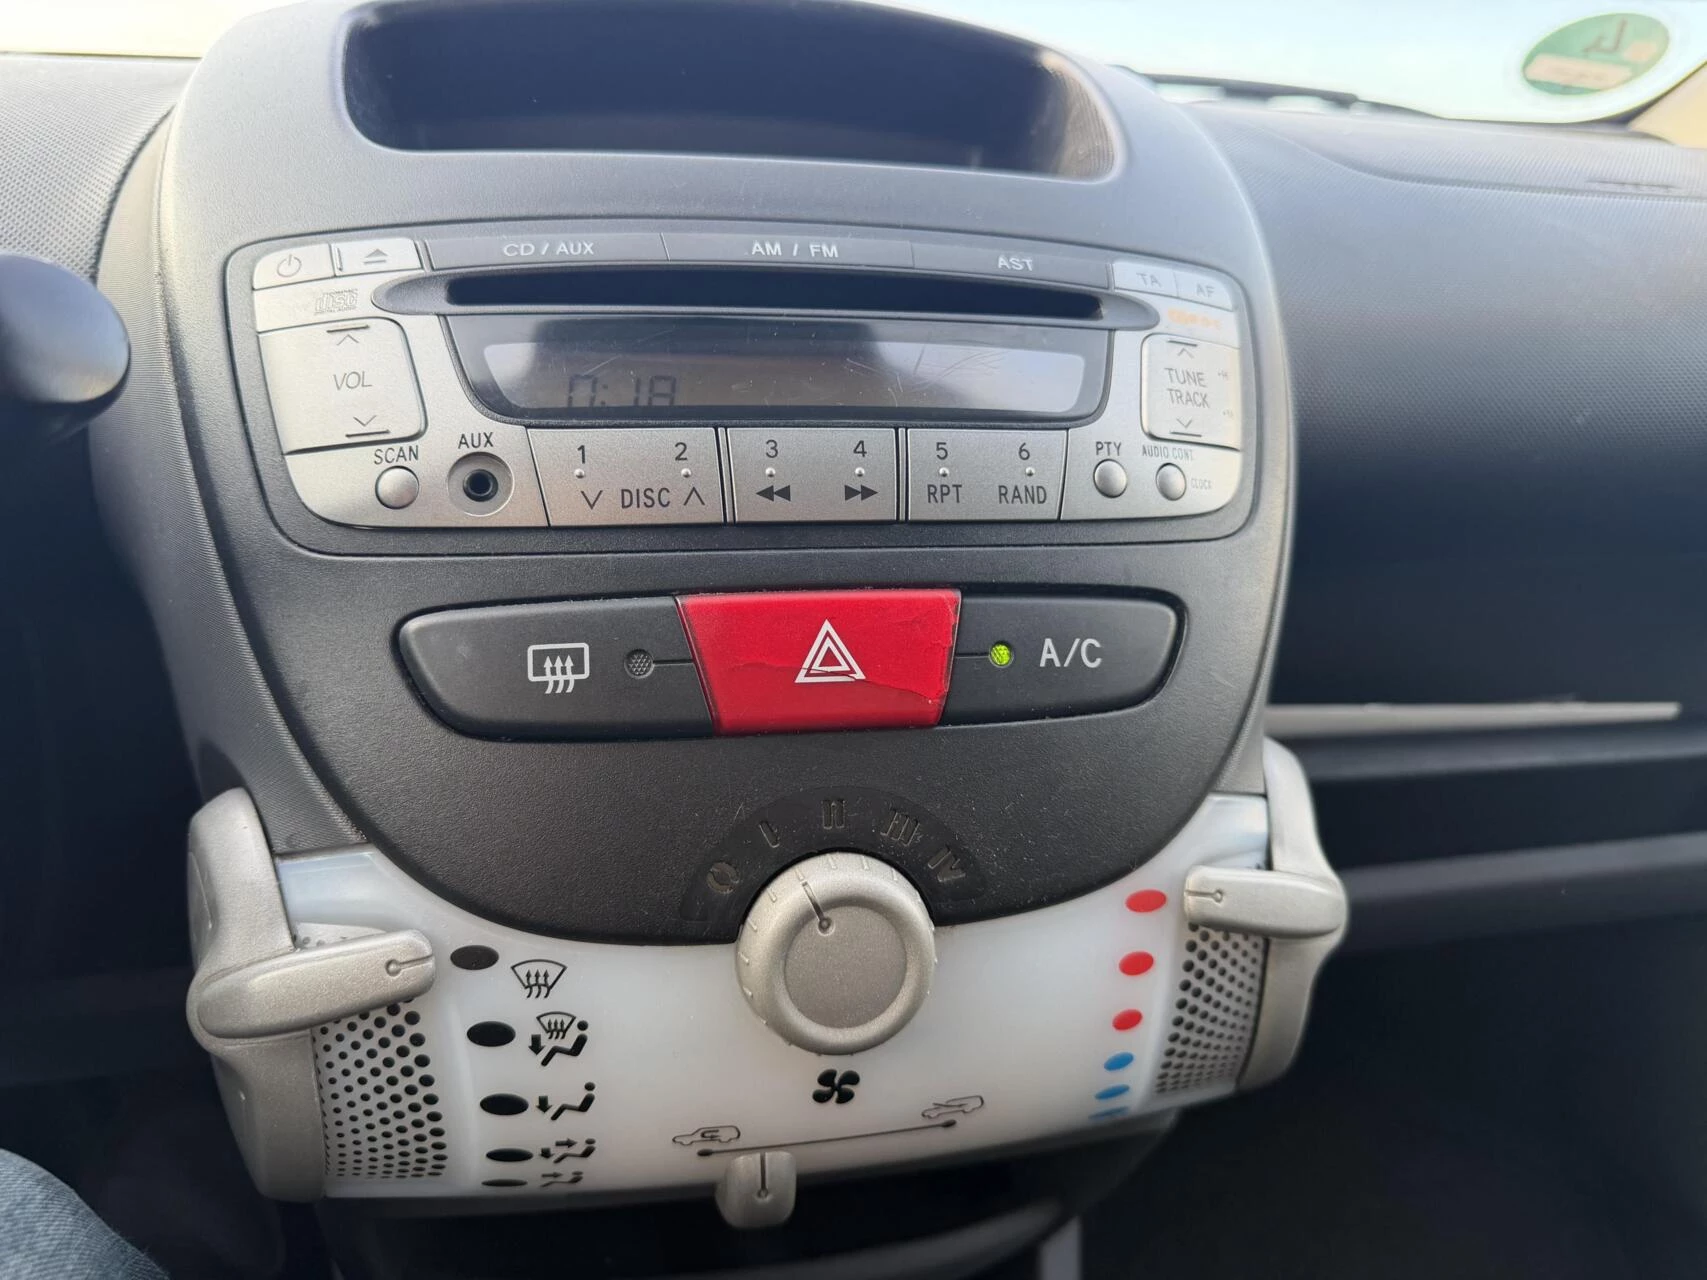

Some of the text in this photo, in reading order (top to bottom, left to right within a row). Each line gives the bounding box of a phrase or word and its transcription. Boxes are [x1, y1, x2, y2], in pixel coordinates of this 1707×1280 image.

[503, 243, 536, 257] CD
[556, 240, 595, 255] AUX
[751, 240, 782, 257] AM
[808, 243, 839, 258] FM
[998, 255, 1033, 272] AST
[1136, 272, 1163, 288] TA
[1196, 283, 1215, 298] AF
[333, 370, 373, 391] VOL
[1164, 368, 1207, 388] TUNE
[1167, 387, 1210, 409] TRACK
[458, 431, 494, 449] AUX
[765, 439, 779, 459] 3
[853, 440, 868, 458] 4
[1095, 440, 1122, 457] PTY
[374, 445, 419, 465] SCAN
[577, 444, 586, 465] 1
[674, 442, 688, 461] 2
[936, 442, 949, 461] 5
[1018, 442, 1031, 461] 6
[1142, 445, 1169, 460] AUDIO
[620, 487, 671, 509] DISC
[926, 484, 963, 504] RPT
[998, 484, 1047, 505] RAND
[1039, 637, 1103, 669] A/C
